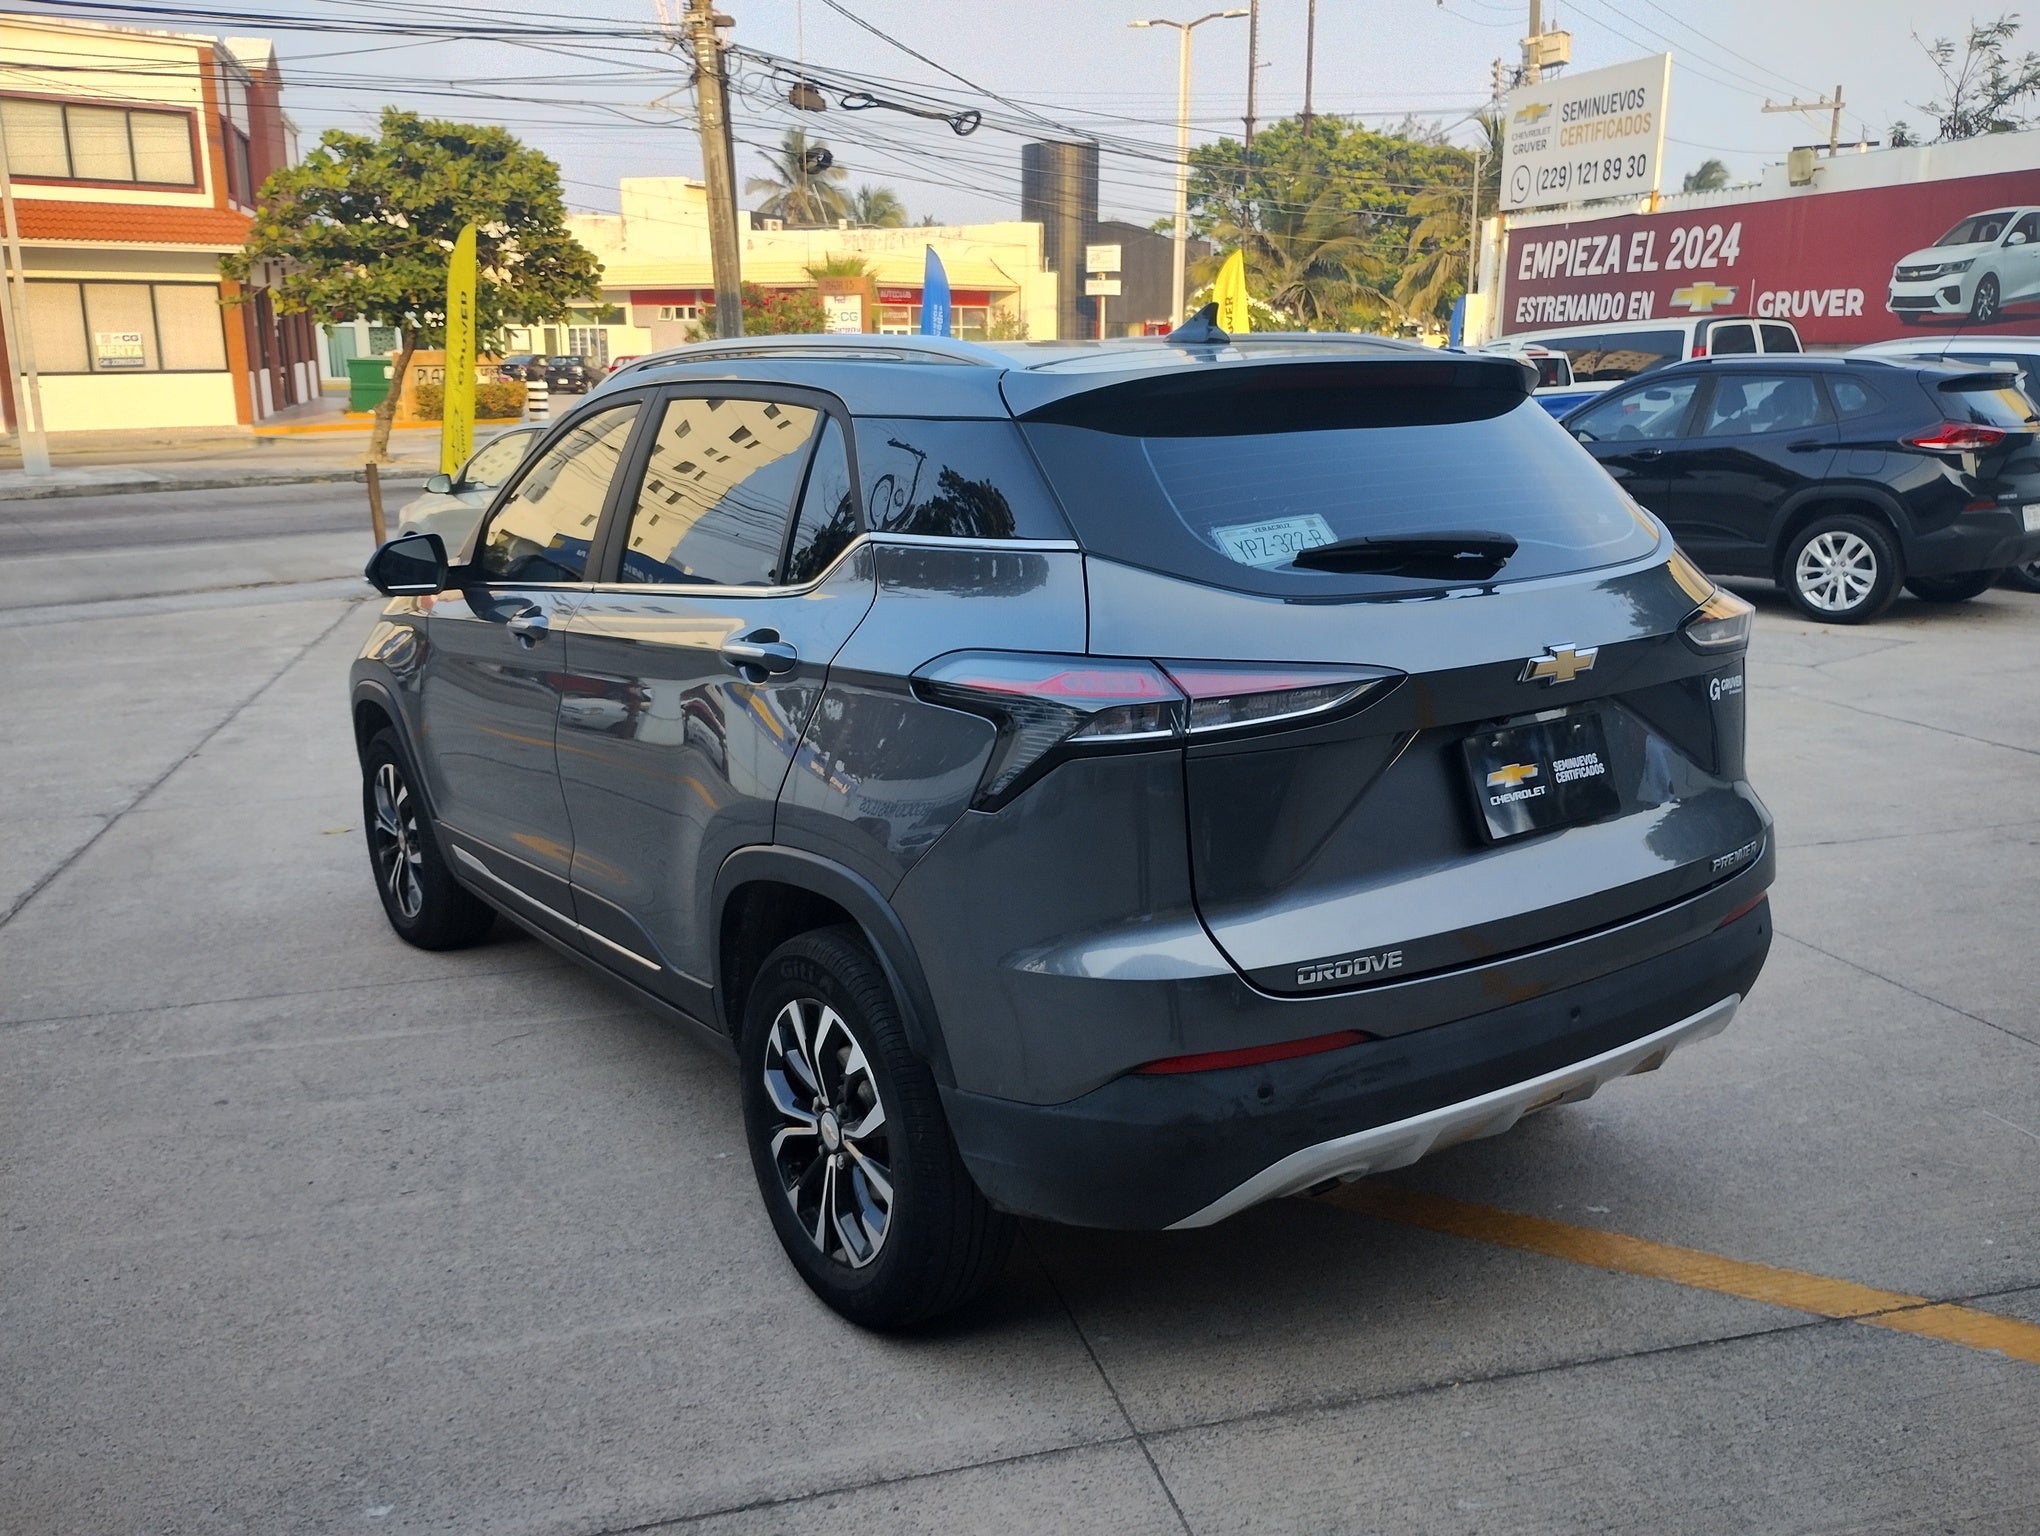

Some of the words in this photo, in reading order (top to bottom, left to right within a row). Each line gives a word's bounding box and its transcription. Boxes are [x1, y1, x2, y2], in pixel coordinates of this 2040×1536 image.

[1562, 87, 1646, 123] SEMINUEVOS
[1511, 126, 1552, 141] CHEVROLET
[1559, 112, 1652, 148] CERTIFICADOS
[1512, 139, 1548, 156] GRUVER
[1536, 161, 1573, 197] (229)
[1576, 160, 1599, 186] 121
[1602, 157, 1622, 182] 89
[1626, 153, 1647, 179] 30
[1518, 234, 1621, 281] EMPIEZA
[1626, 230, 1659, 273] EL
[1664, 221, 1742, 270] 2024
[840, 312, 858, 322] CG
[1515, 293, 1626, 323] ESTRENANDO
[1627, 291, 1655, 321] EN
[1757, 288, 1865, 318] GRUVER
[1252, 522, 1291, 534] VERACRUZ
[1552, 752, 1598, 773] SEMINUEVOS
[1555, 763, 1605, 784] CERTIFICADOS
[1490, 785, 1546, 806] CHEVROLET
[1712, 840, 1757, 873] PREMIER
[1297, 950, 1402, 985] GROOVE
